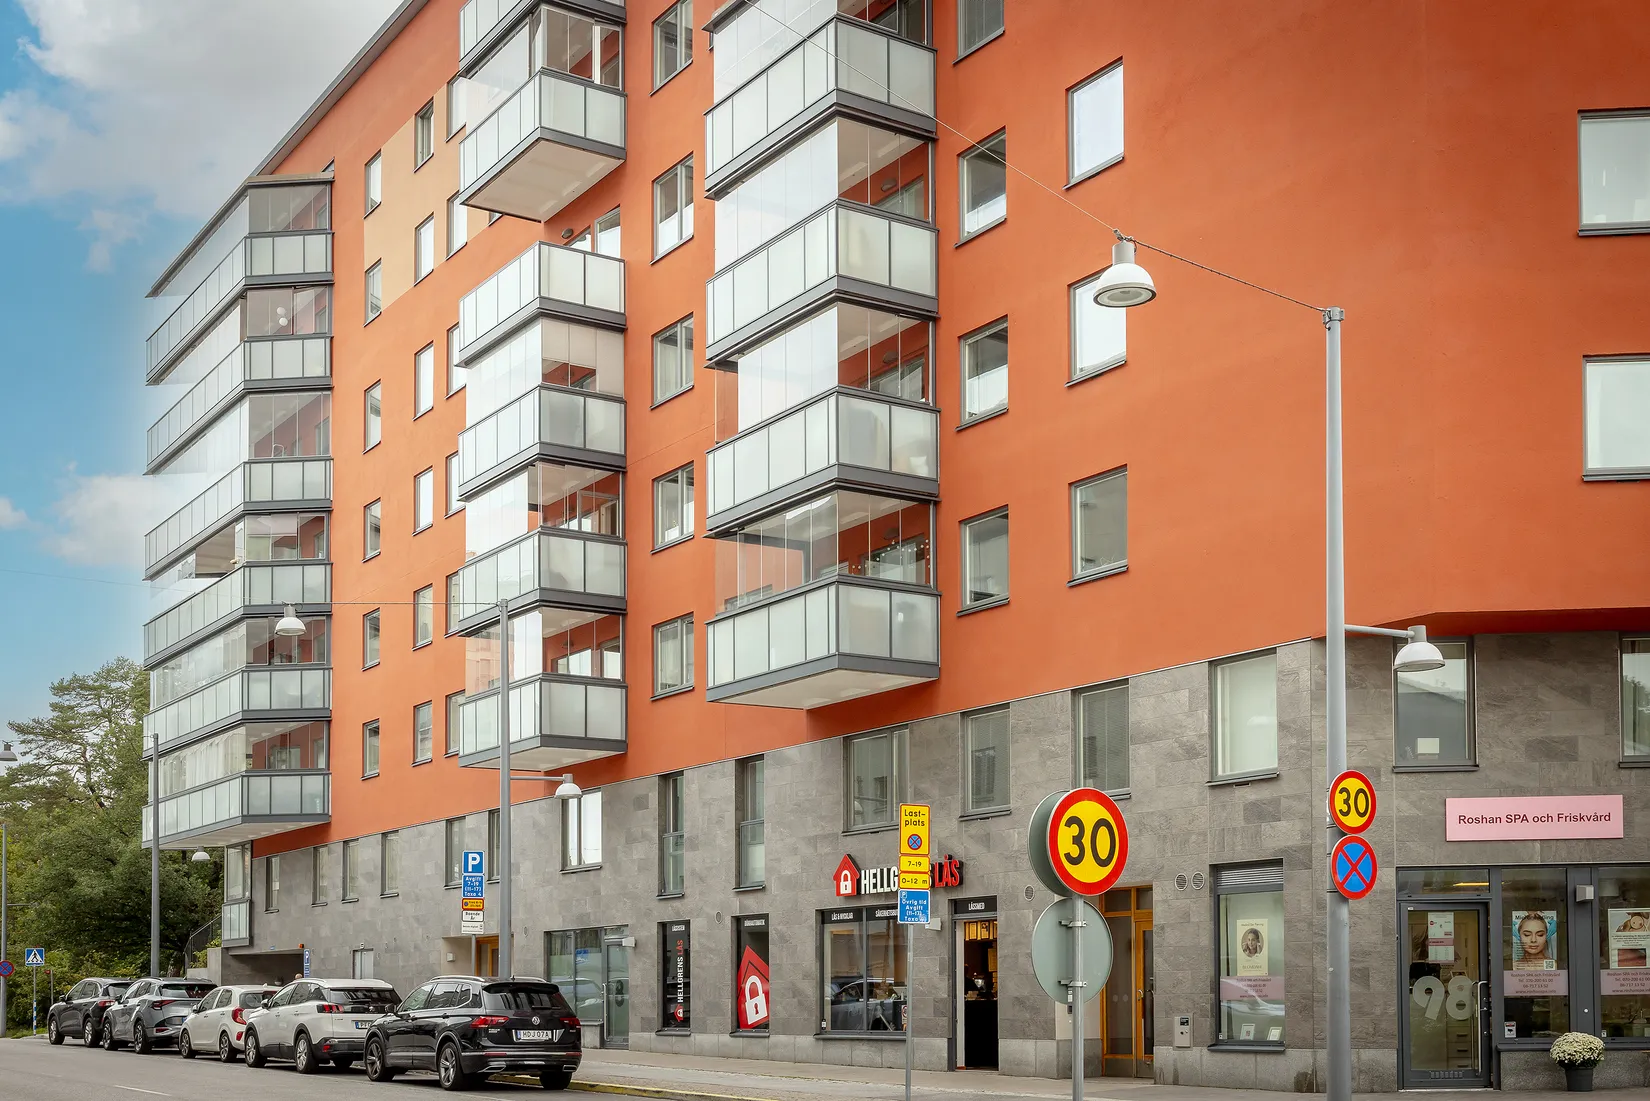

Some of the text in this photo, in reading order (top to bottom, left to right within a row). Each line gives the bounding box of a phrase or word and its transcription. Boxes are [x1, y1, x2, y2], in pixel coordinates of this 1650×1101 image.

[1339, 786, 1370, 818] 30
[904, 809, 926, 818] Last-
[1458, 812, 1611, 825] Roshan SPA och Friskvård
[904, 819, 925, 827] plats
[1063, 815, 1117, 868] 30
[468, 853, 481, 872] P
[907, 860, 922, 868] 7-19
[934, 854, 961, 888] LÅS
[901, 877, 918, 885] 0-12
[676, 939, 684, 955] LÅS
[1412, 975, 1476, 1021] 98
